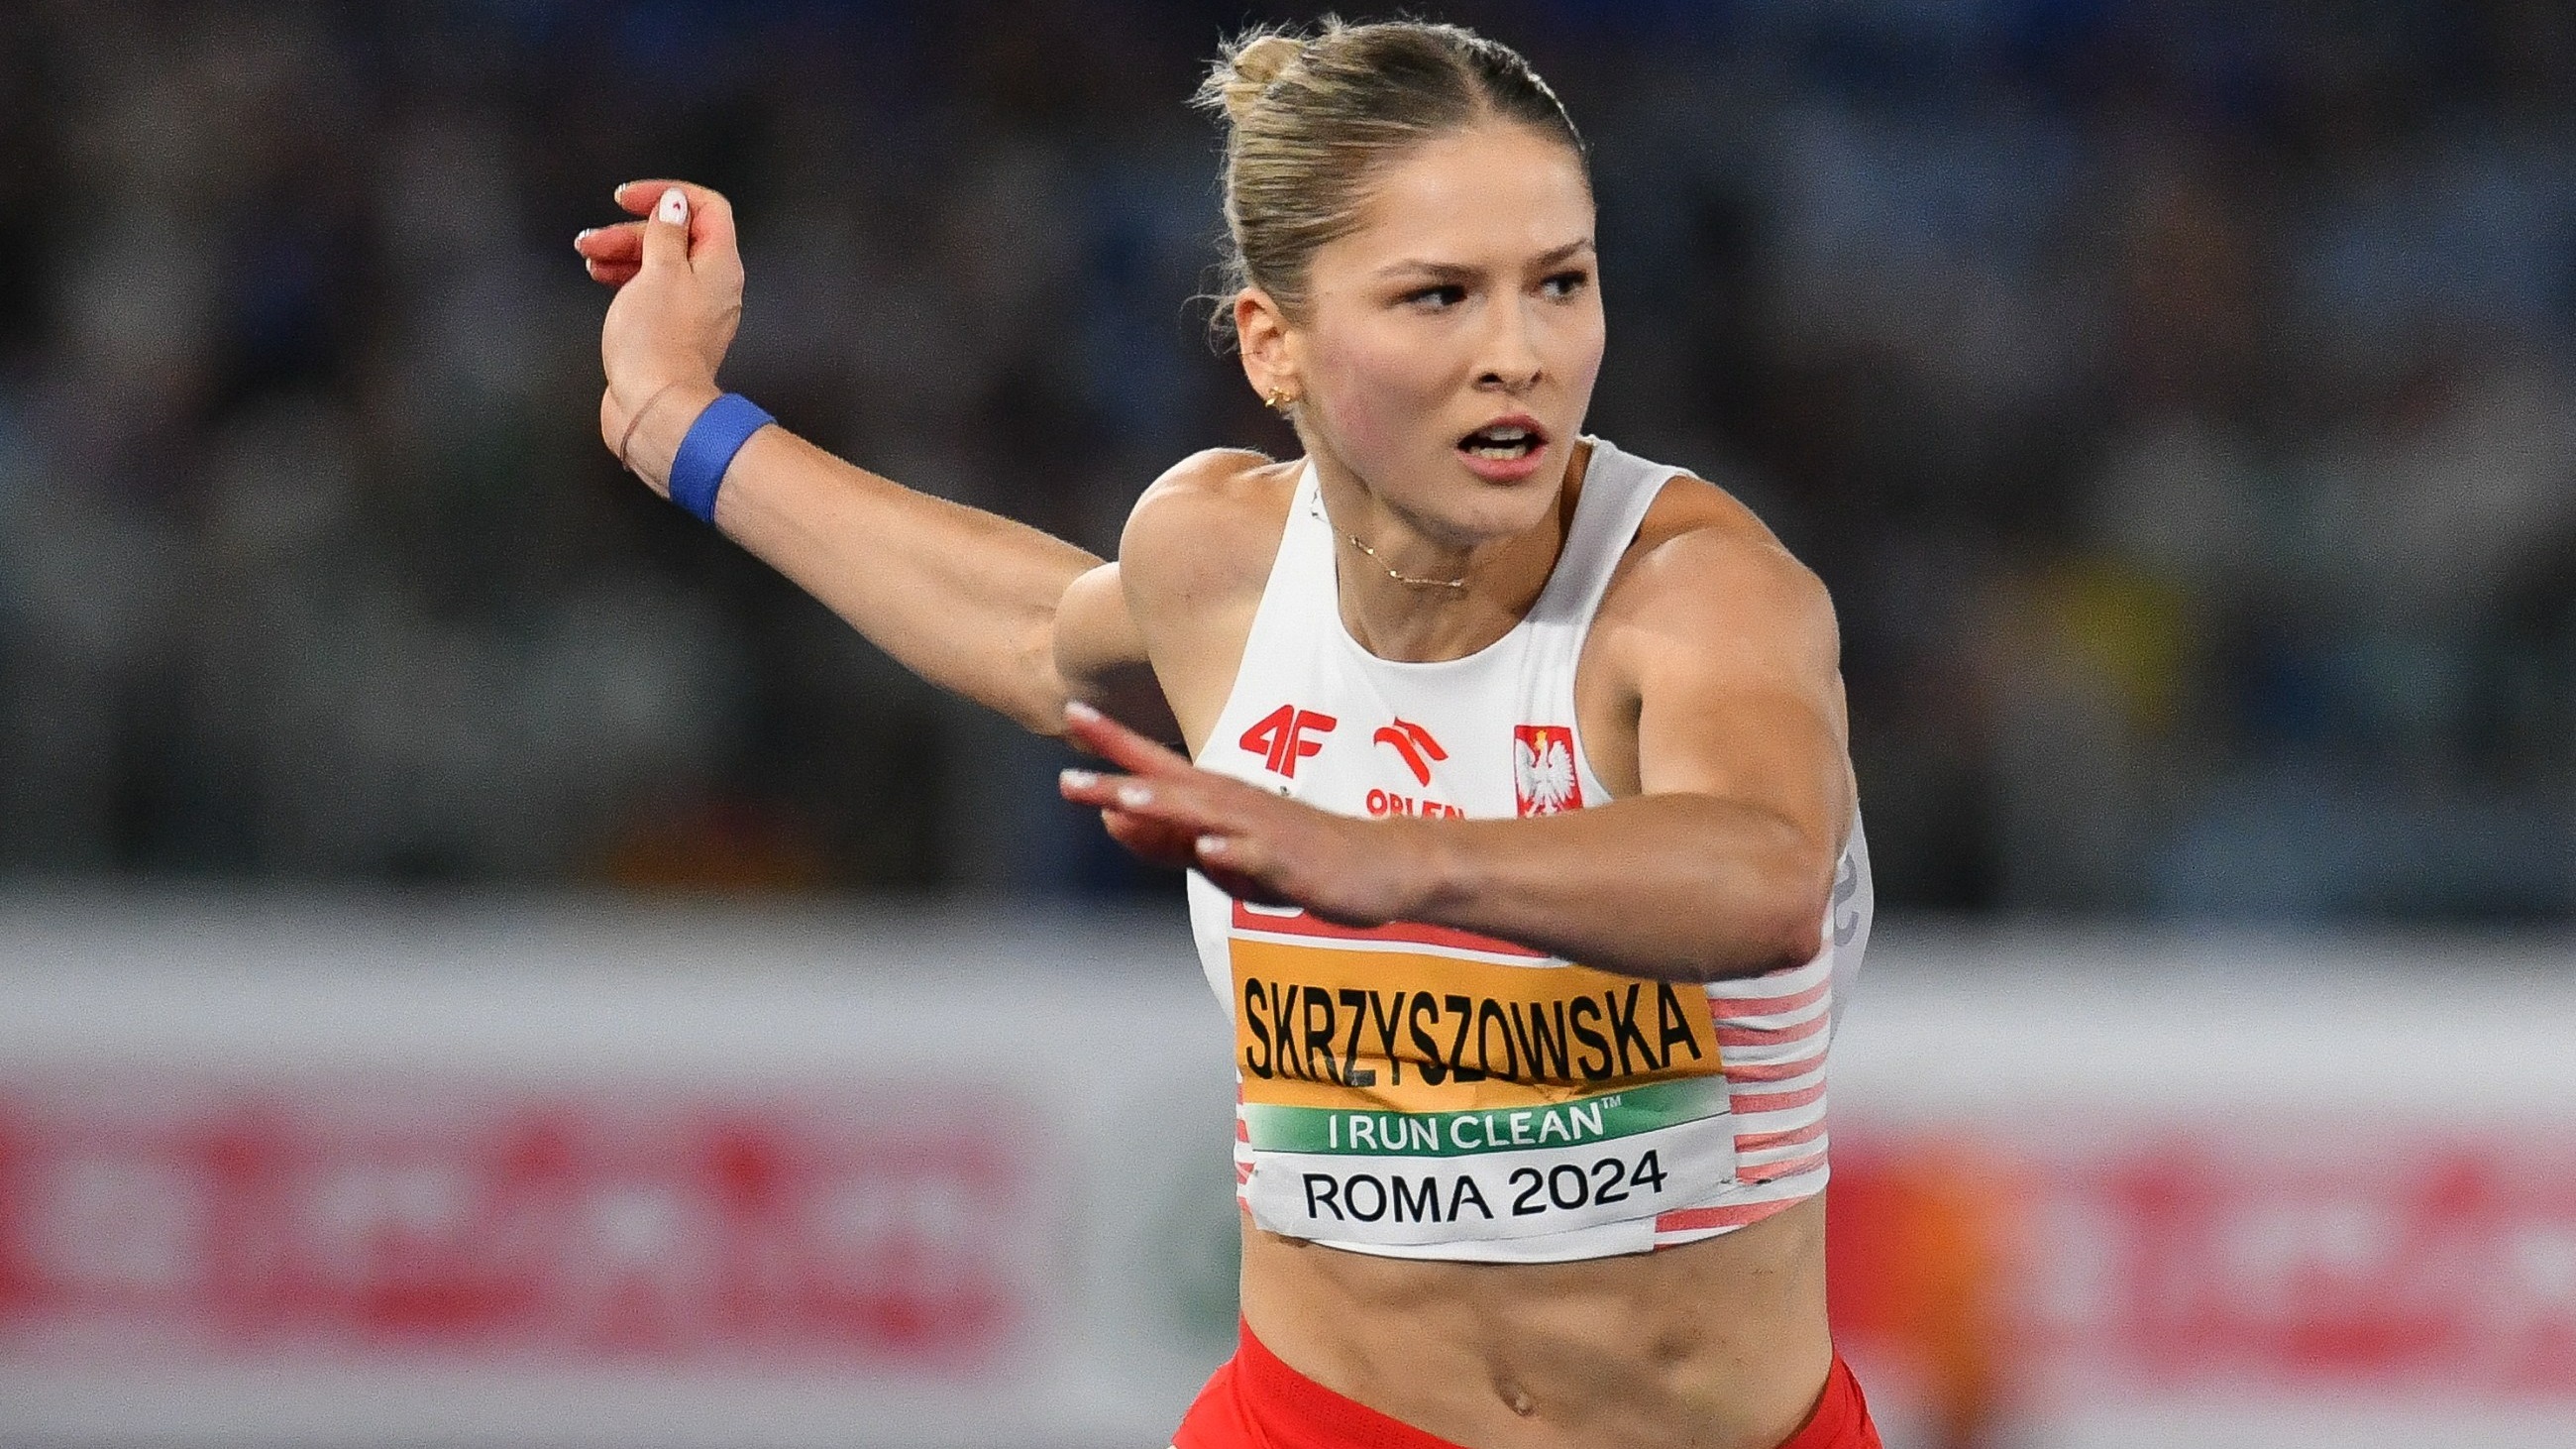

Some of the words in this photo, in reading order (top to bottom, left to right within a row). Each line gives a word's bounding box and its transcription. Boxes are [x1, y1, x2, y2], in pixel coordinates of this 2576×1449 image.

[1239, 705, 1337, 779] 4F
[1243, 978, 1701, 1087] SKRZYSZOWSKA
[1329, 1115, 1338, 1149] I
[1348, 1117, 1440, 1149] RUN
[1303, 1171, 1494, 1223] ROMA
[1509, 1150, 1668, 1216] 2024
